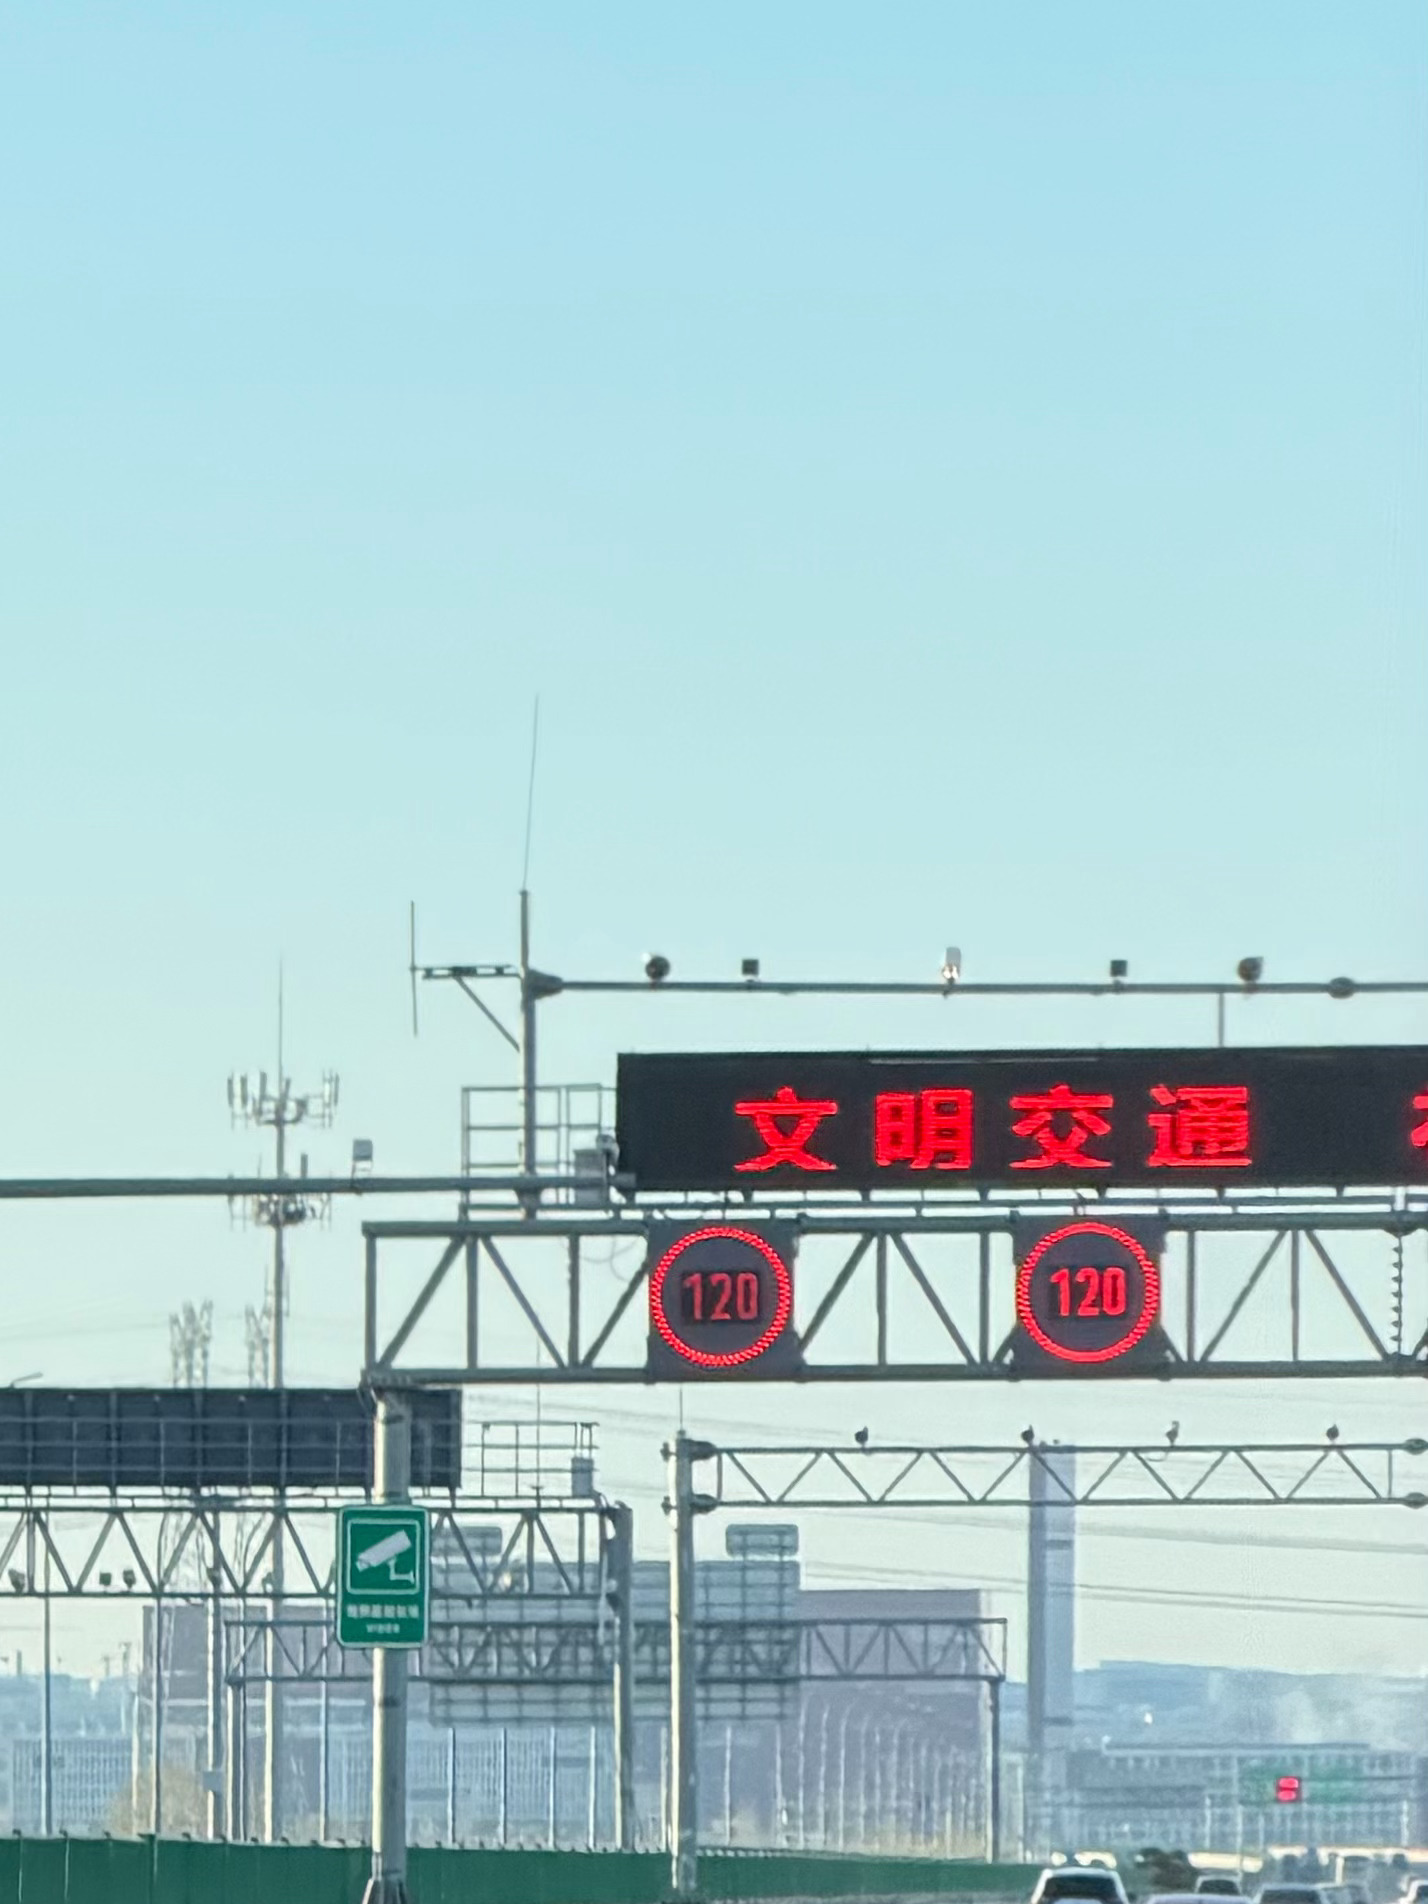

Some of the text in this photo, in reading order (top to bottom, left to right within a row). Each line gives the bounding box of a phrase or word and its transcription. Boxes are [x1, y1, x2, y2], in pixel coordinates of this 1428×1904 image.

[734, 1084, 1251, 1171] 文明交通
[683, 1272, 758, 1320] 120
[1050, 1267, 1126, 1316] 120
